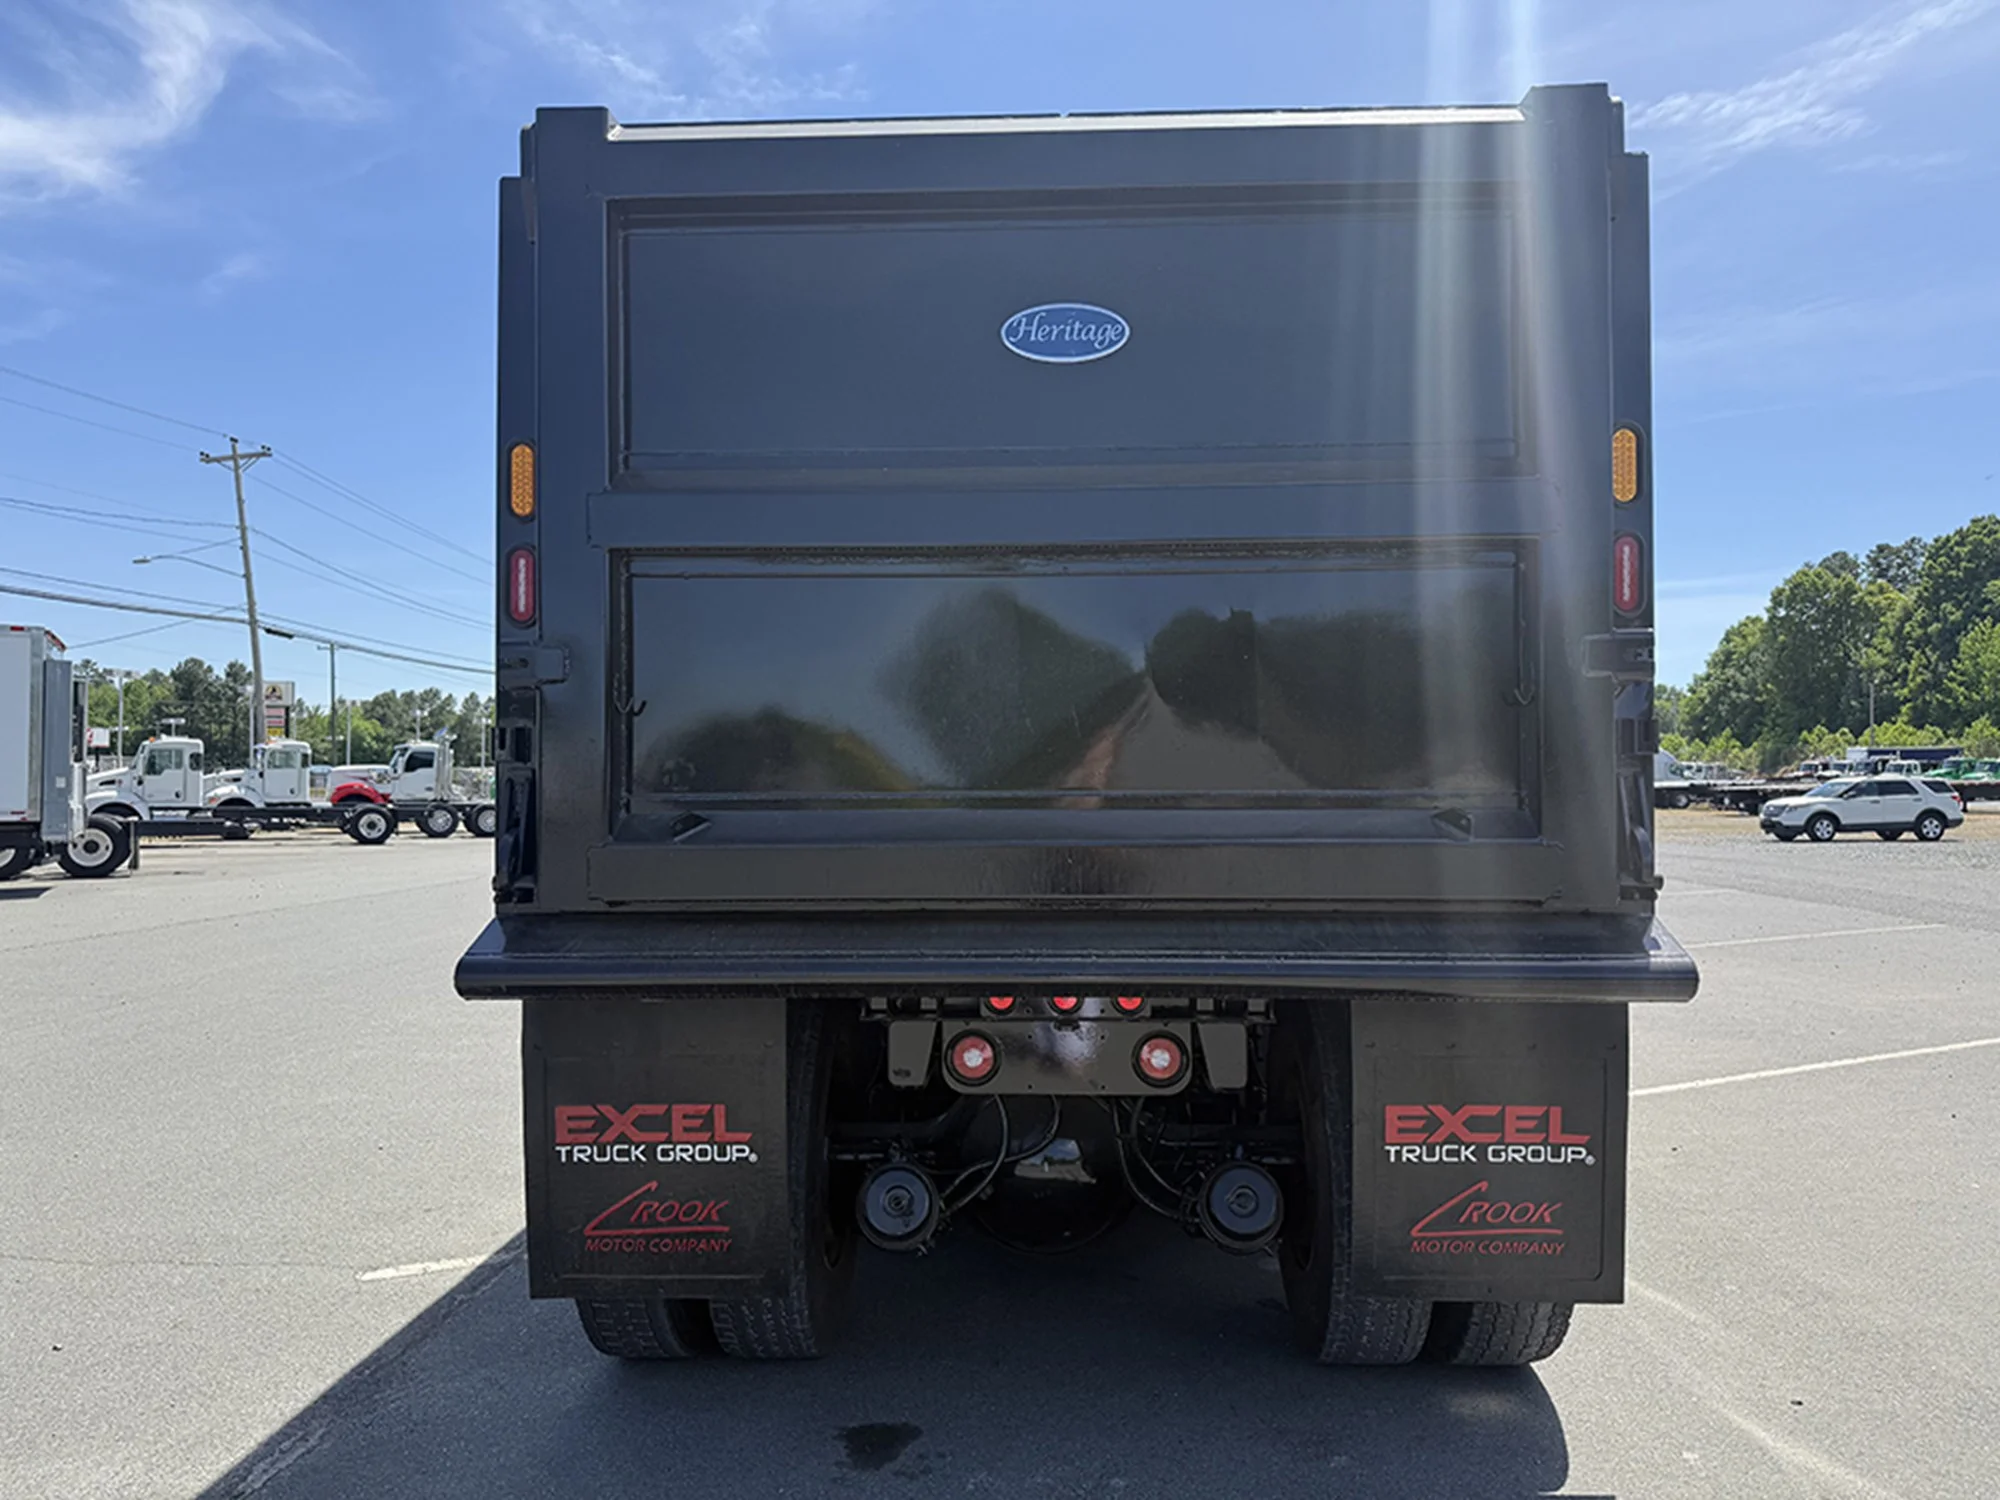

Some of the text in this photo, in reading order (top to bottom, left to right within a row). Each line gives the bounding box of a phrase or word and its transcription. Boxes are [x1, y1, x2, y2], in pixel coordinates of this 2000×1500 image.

[1009, 312, 1122, 349] Heritage
[555, 1104, 752, 1143] EXCEL
[1385, 1105, 1591, 1144] EXCEL
[555, 1145, 647, 1162] TRUCK
[1384, 1145, 1478, 1163] TRUCK
[584, 1238, 732, 1252] MOTOR COMPANY
[1411, 1240, 1564, 1255] MOTOR COMPANY
